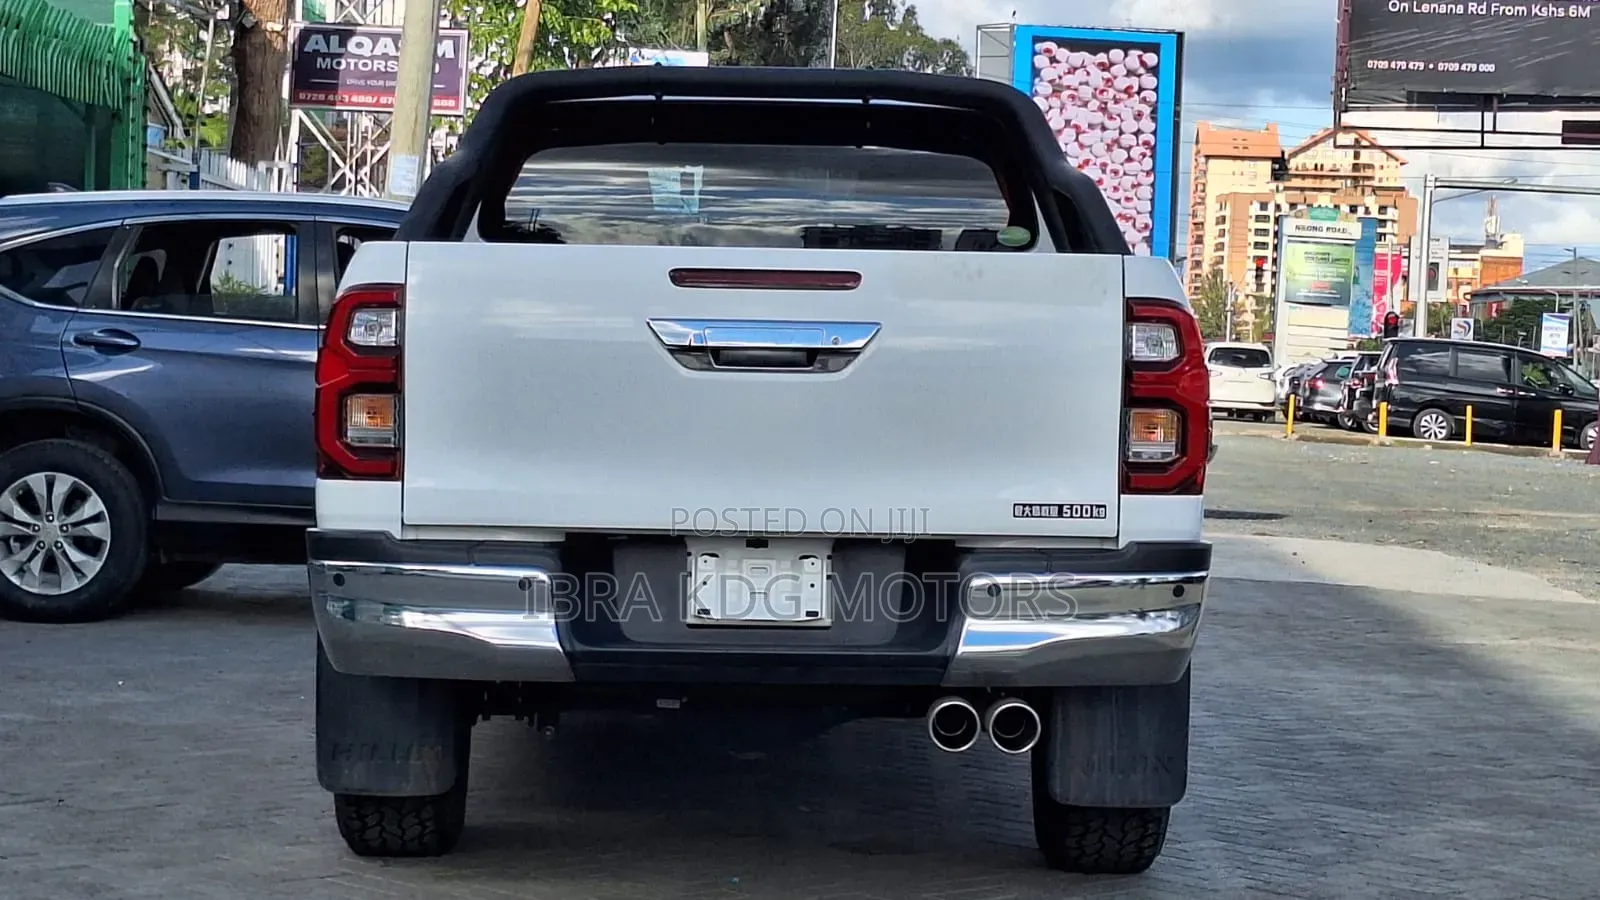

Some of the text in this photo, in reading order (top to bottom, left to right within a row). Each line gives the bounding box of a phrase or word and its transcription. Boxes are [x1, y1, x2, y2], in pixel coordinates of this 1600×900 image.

[1388, 0, 1591, 18] On Lenana Rd From Kshs 6M
[303, 33, 455, 59] ALQAM
[316, 57, 399, 73] MOTORS
[1478, 63, 1496, 73] 000
[1062, 504, 1106, 518] 500kg
